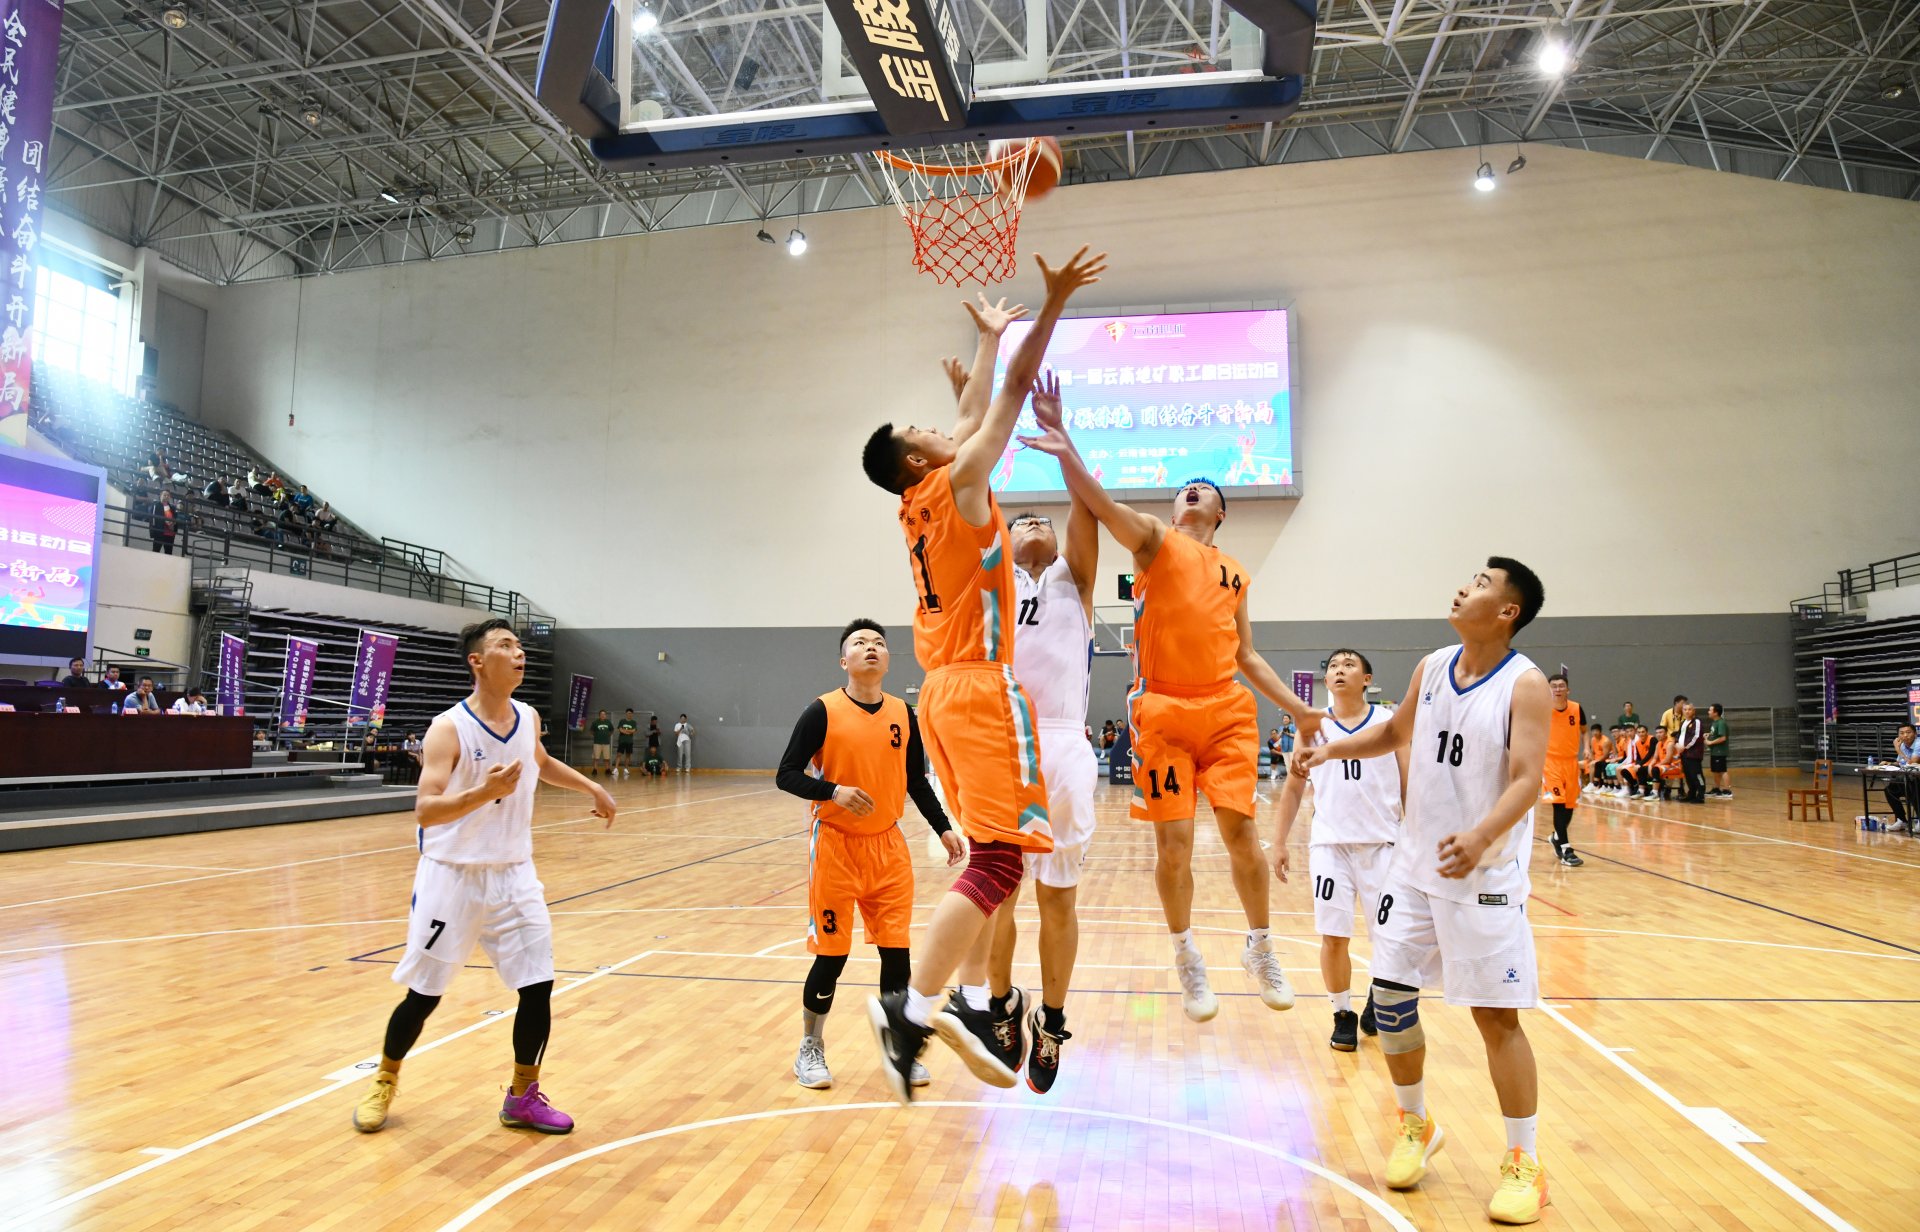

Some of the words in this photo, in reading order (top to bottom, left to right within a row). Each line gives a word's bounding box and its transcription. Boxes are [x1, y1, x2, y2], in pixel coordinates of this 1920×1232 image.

[1219, 564, 1242, 598] 14
[1018, 596, 1039, 625] 12
[889, 723, 902, 750] 3
[1436, 730, 1464, 767] 18
[1148, 765, 1181, 800] 14
[1342, 759, 1362, 781] 10
[1315, 875, 1335, 901] 10
[822, 909, 838, 936] 3
[1375, 892, 1394, 926] 8
[424, 919, 446, 950] 7
